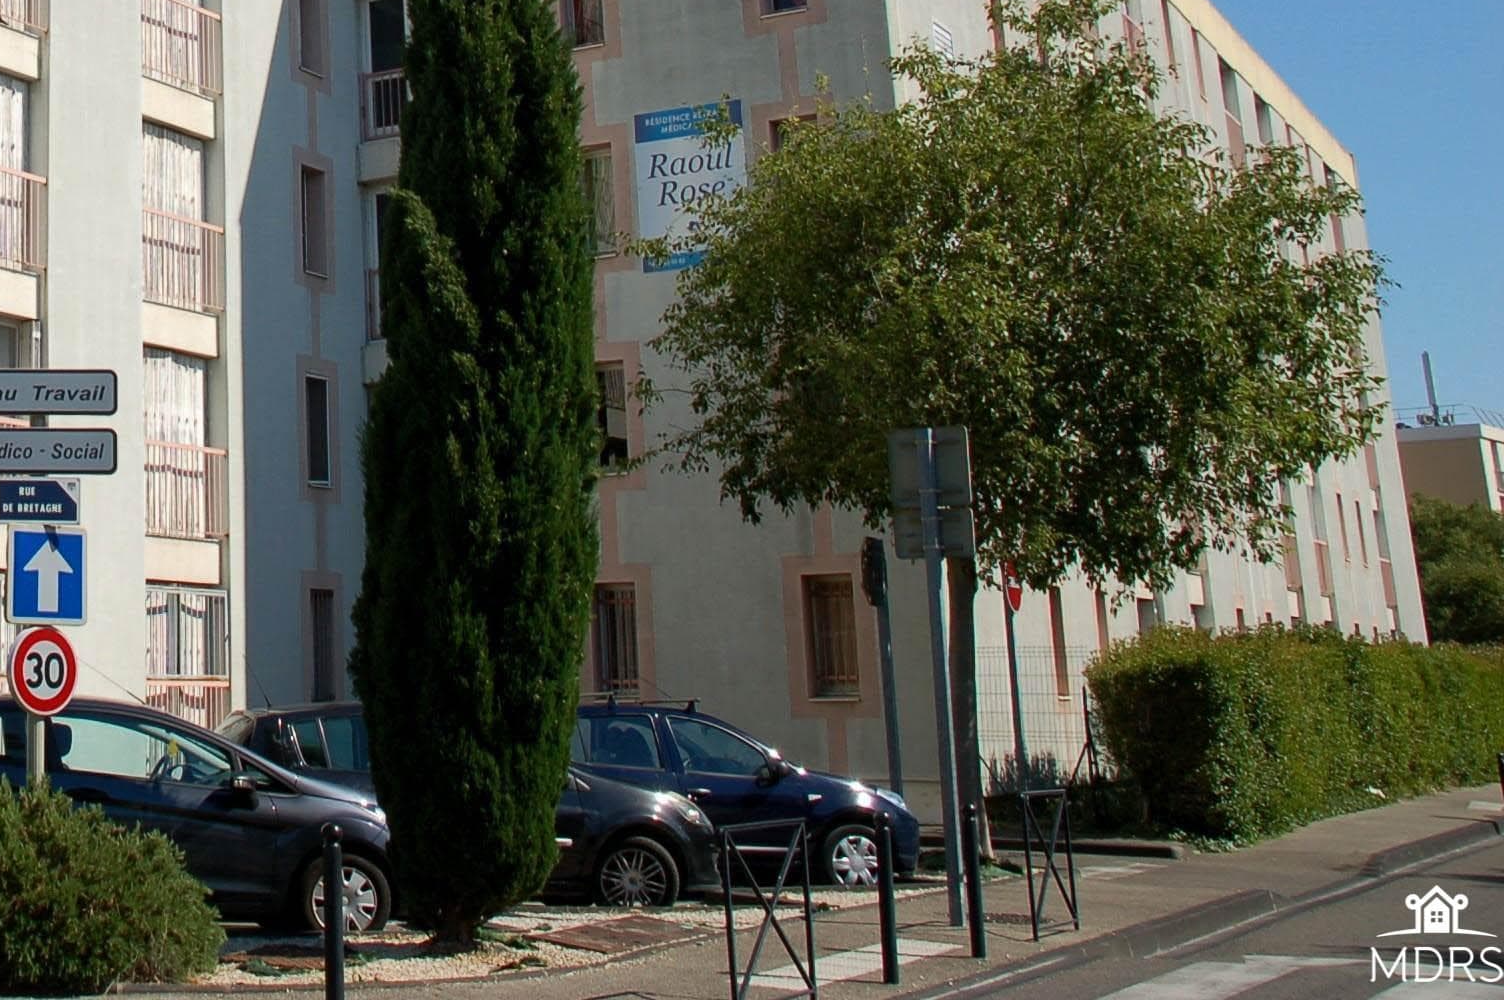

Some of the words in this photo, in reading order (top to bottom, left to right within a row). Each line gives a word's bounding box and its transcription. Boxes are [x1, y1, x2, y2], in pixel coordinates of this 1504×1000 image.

[648, 141, 732, 180] Raoul
[657, 179, 726, 207] Rose
[32, 384, 106, 402] Travail
[50, 442, 105, 461] Social
[18, 486, 36, 496] RUE
[2, 503, 13, 513] DE
[17, 503, 63, 513] BRETAGNE
[25, 651, 65, 689] 30
